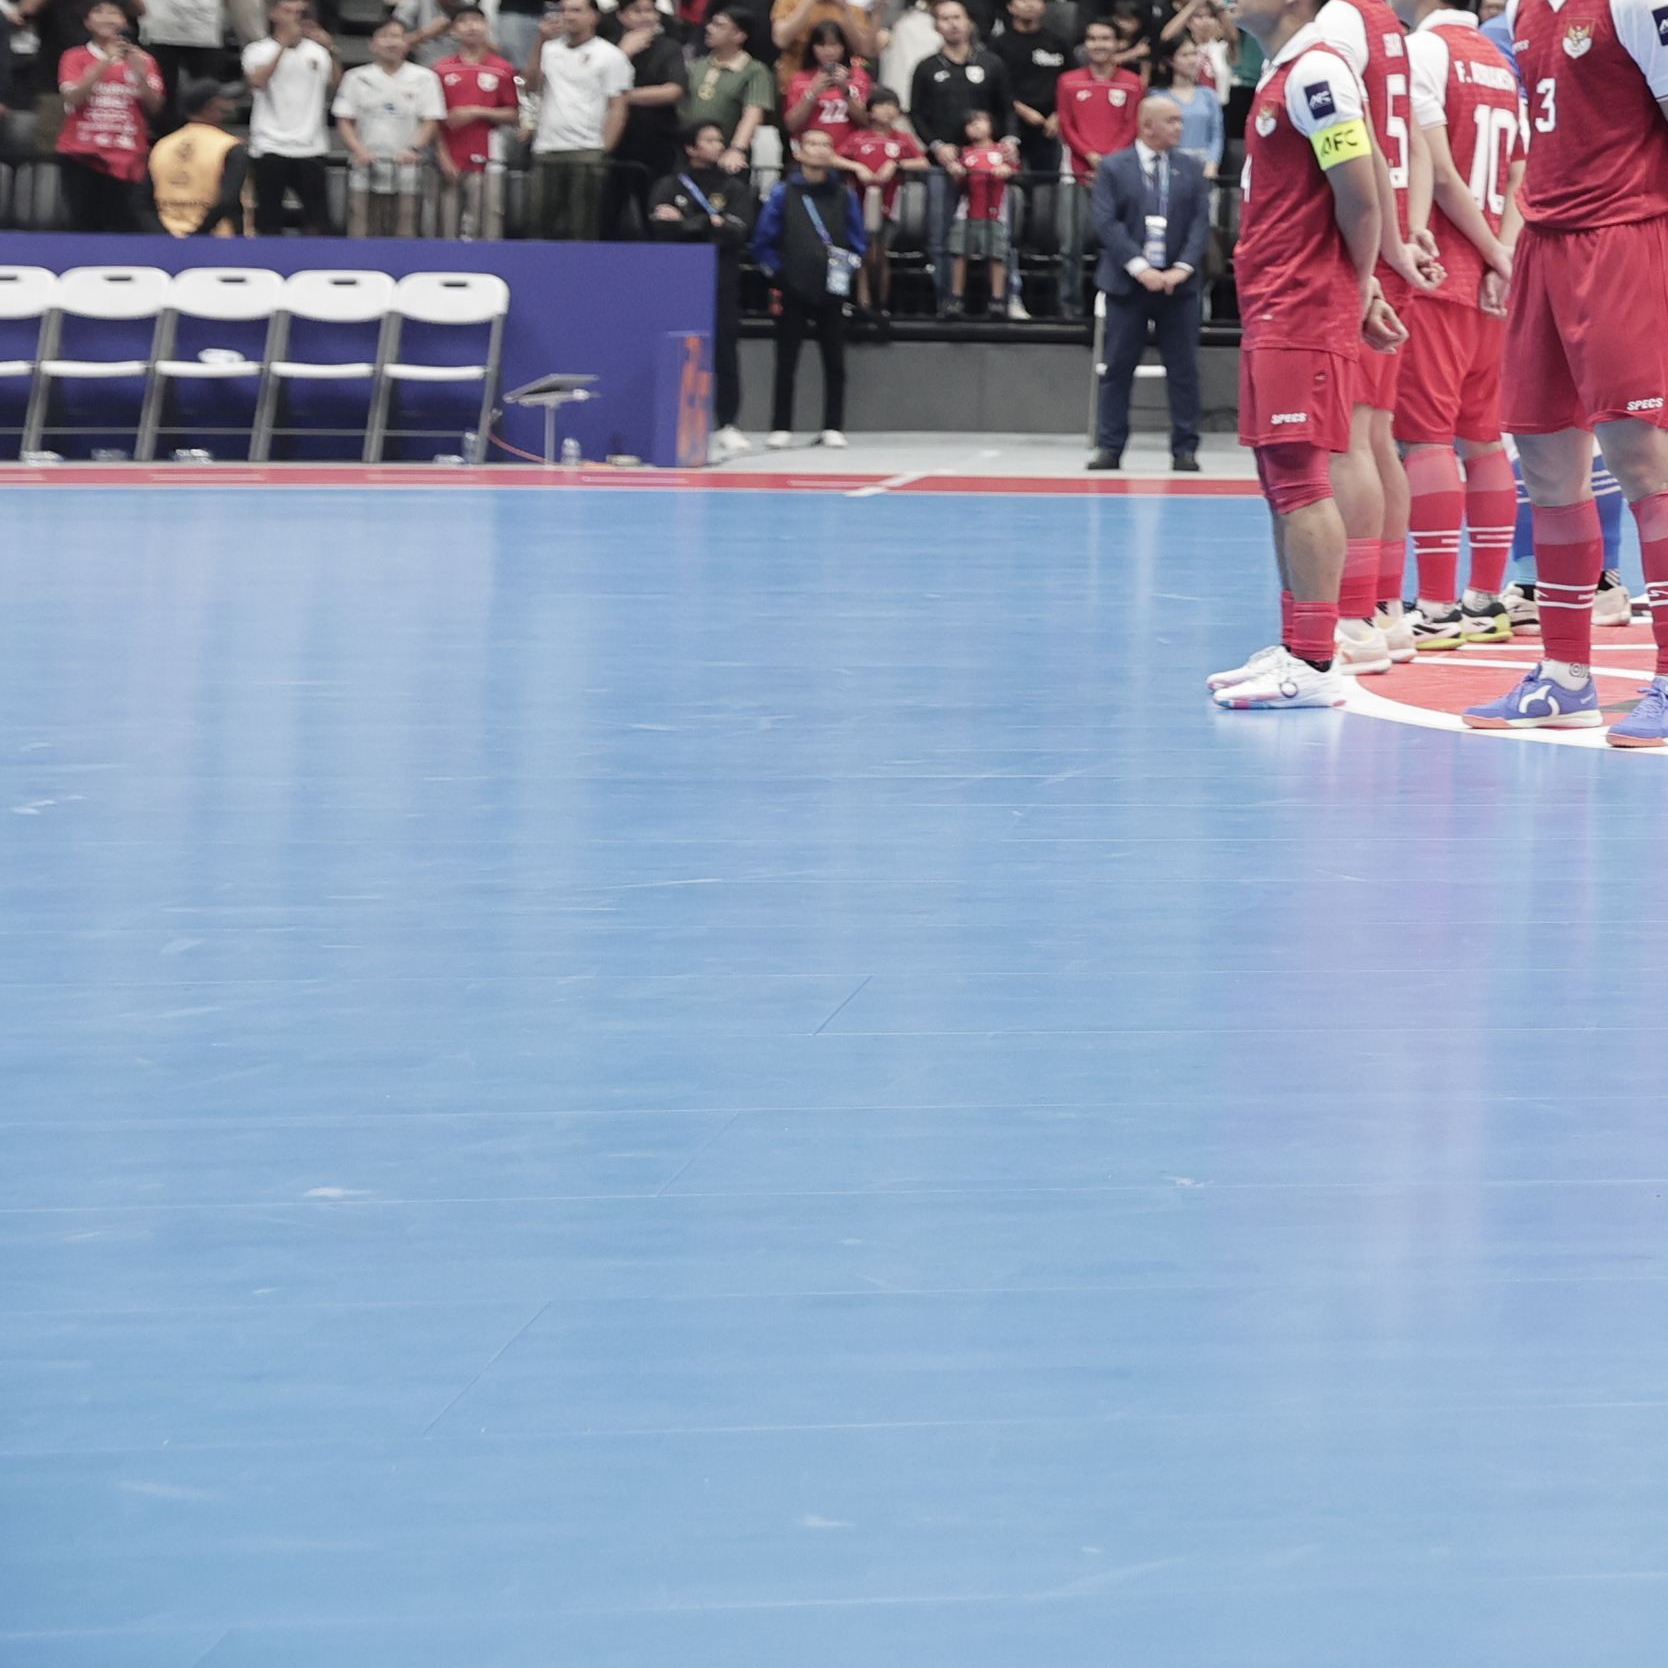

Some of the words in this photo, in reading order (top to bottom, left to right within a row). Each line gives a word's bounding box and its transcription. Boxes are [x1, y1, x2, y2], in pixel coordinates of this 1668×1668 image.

[1535, 78, 1556, 133] 3
[1321, 129, 1358, 157] AFC
[1469, 104, 1519, 216] 10
[1627, 397, 1664, 411] SPECS
[1271, 412, 1307, 425] SPECS
